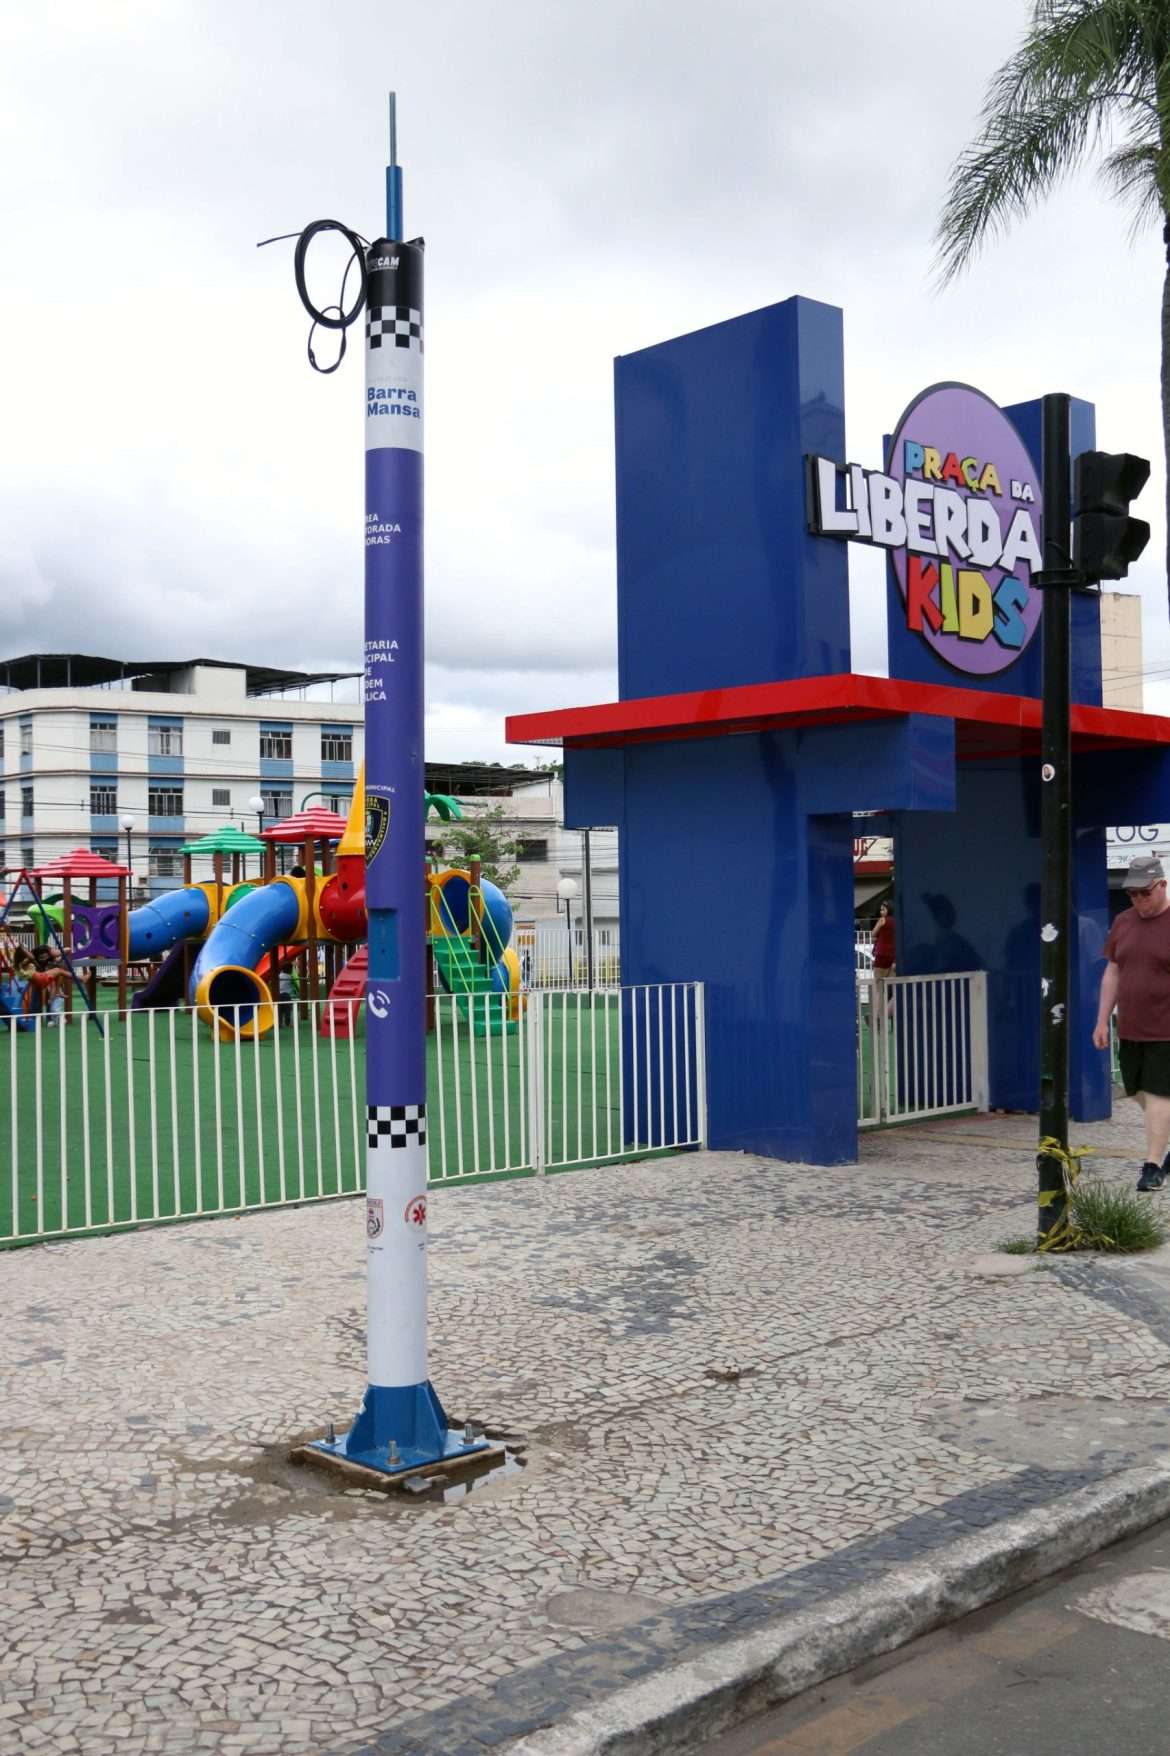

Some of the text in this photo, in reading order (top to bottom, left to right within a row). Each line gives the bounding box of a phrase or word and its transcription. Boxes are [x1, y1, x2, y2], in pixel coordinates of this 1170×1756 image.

[367, 387, 417, 402] Barra
[367, 402, 420, 418] Mansa
[904, 439, 1034, 502] PRAÇA DA
[817, 456, 1043, 574] LIBERDA
[907, 555, 1029, 648] KIDS
